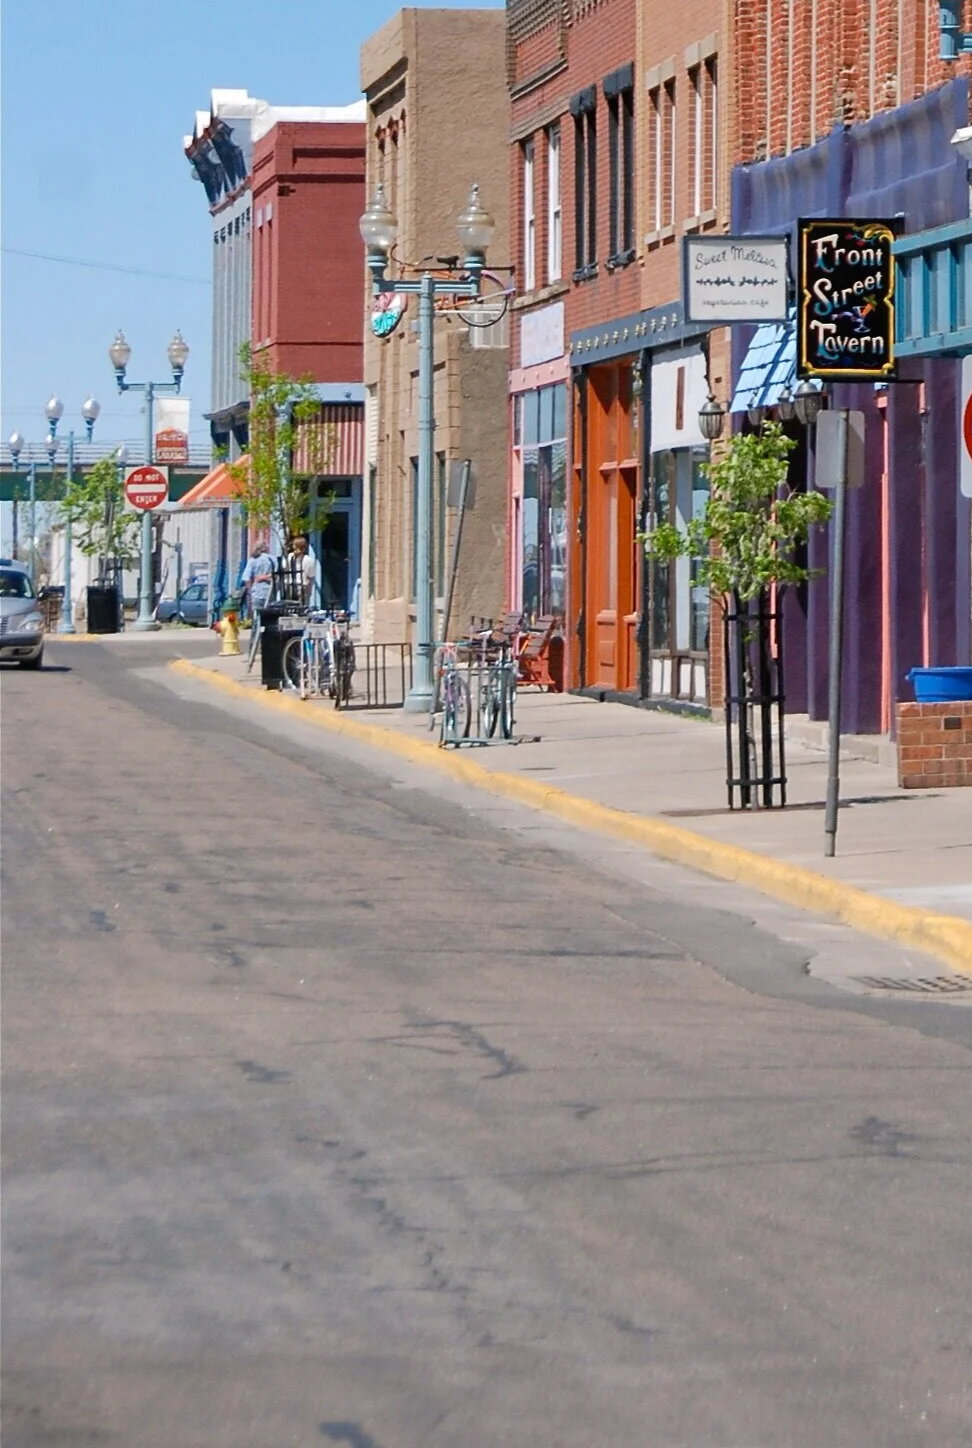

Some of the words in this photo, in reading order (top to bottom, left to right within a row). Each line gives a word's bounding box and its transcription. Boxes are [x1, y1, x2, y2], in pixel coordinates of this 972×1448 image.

[695, 249, 728, 270] Sweet
[810, 233, 883, 272] Front
[813, 271, 883, 316] Street
[810, 319, 884, 360] Tavern
[145, 473, 160, 481] NOT
